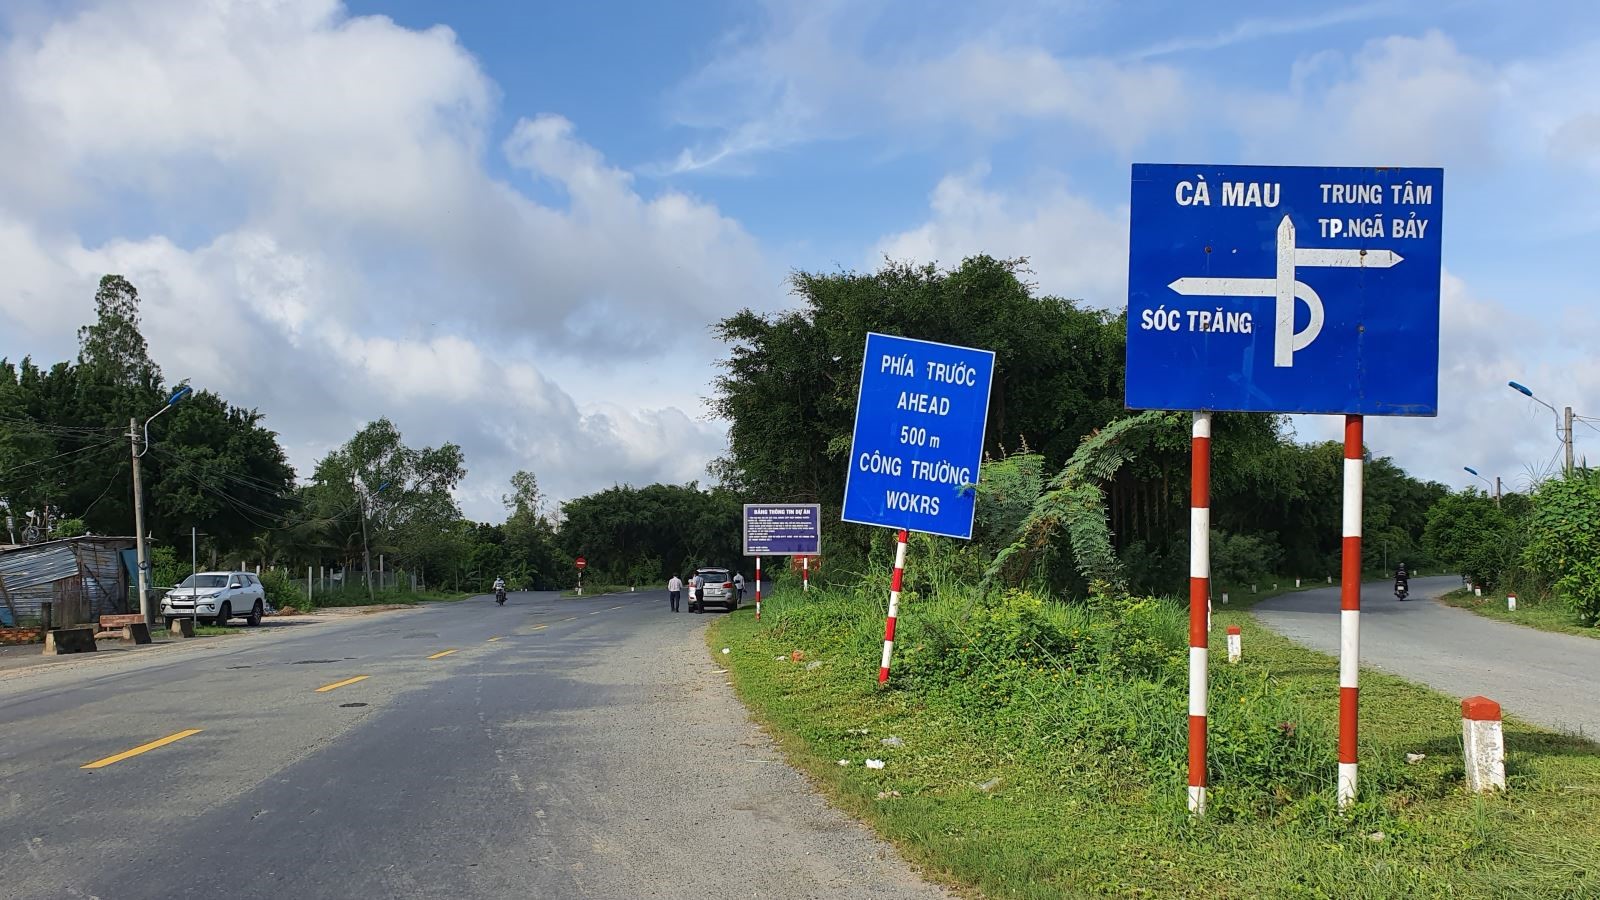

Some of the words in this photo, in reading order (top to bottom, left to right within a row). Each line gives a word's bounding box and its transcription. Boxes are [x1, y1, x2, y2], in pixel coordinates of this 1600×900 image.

[1175, 174, 1210, 207] CÀ
[1221, 182, 1281, 208] MAU
[1320, 183, 1382, 205] TRUNG
[1391, 180, 1433, 205] TÂM
[1318, 213, 1385, 239] TP.NGÃ
[1392, 211, 1429, 239] BẢY
[1140, 304, 1181, 332] SÓC
[1186, 306, 1252, 334] TRĂNG
[881, 353, 914, 377] PHÍA
[927, 361, 976, 387] TRƯỚC
[897, 391, 950, 416] AHEAD
[900, 425, 926, 447] 500
[929, 435, 940, 449] m
[859, 449, 902, 477] CÔNG
[911, 459, 970, 486] TRƯỜNG
[886, 490, 940, 516] WOKRS
